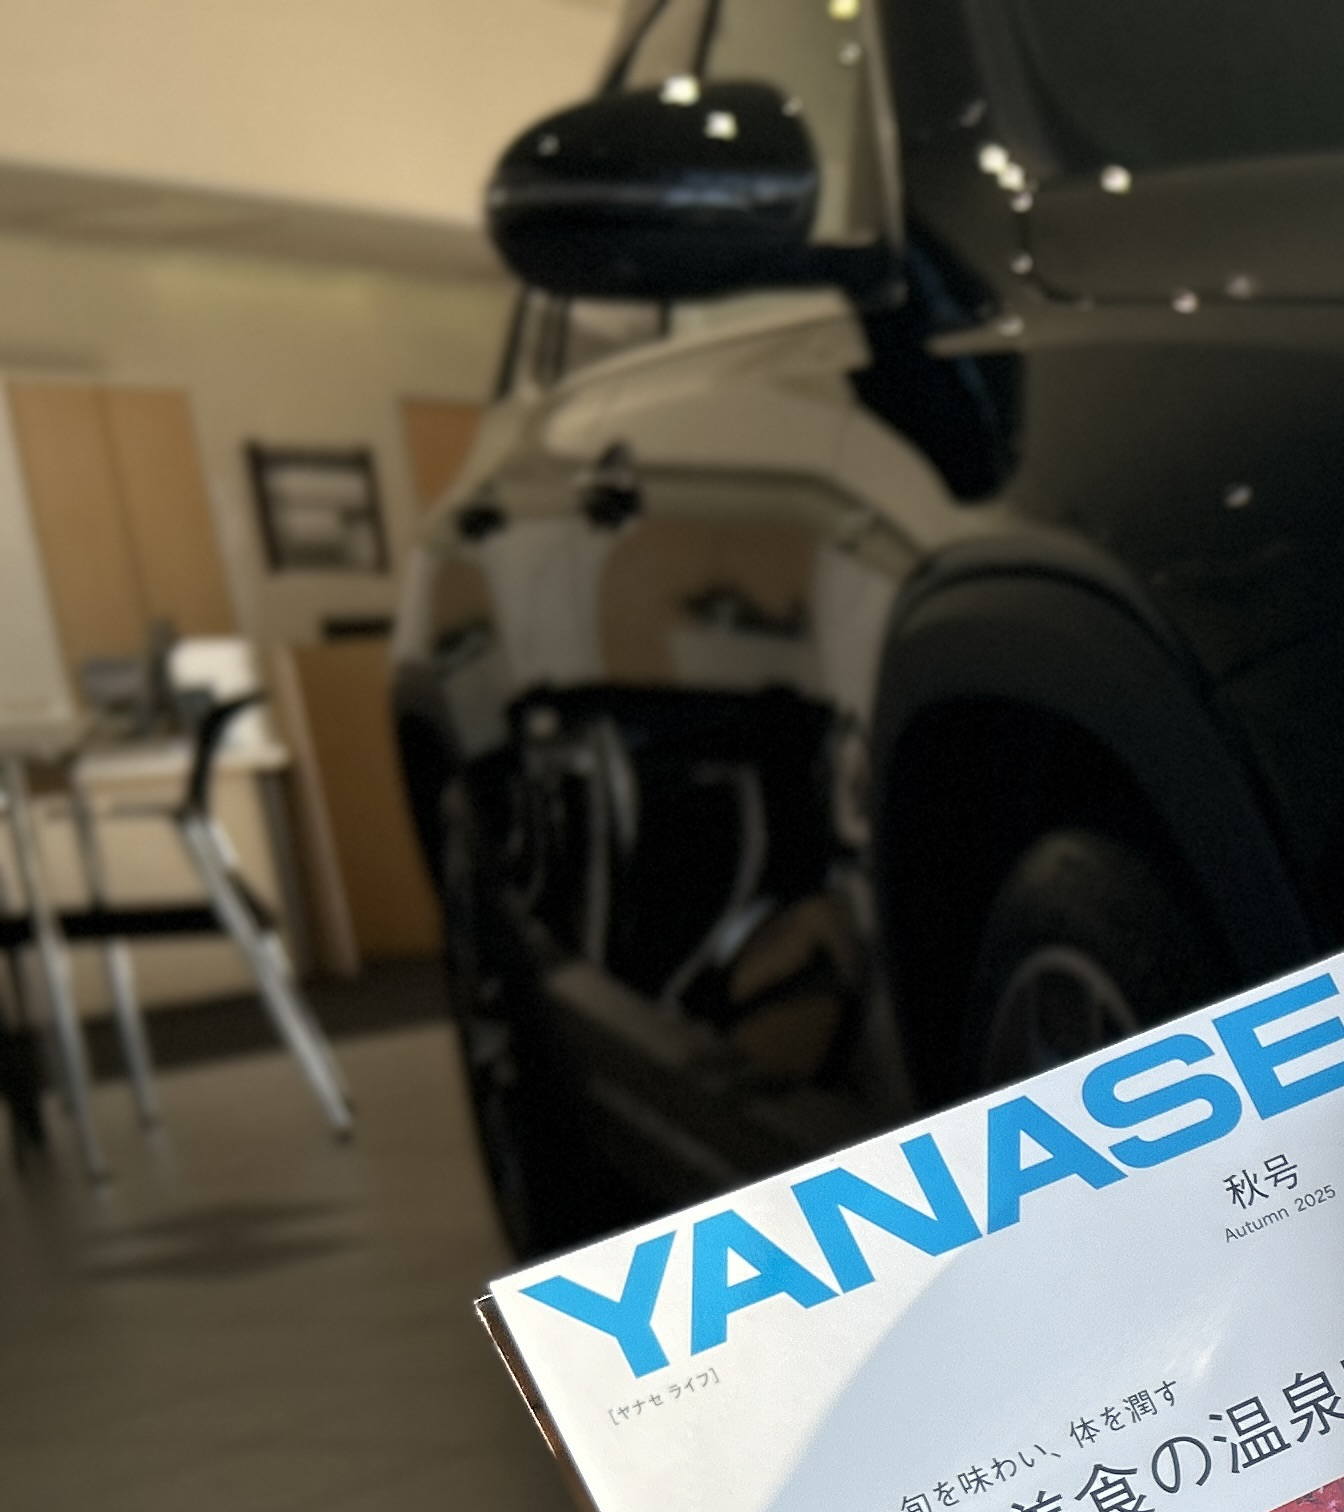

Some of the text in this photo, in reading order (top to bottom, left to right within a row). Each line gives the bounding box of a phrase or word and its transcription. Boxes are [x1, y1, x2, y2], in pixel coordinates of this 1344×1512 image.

[1223, 1154, 1300, 1210] 秋号
[1223, 1184, 1337, 1243] Autumn 2025
